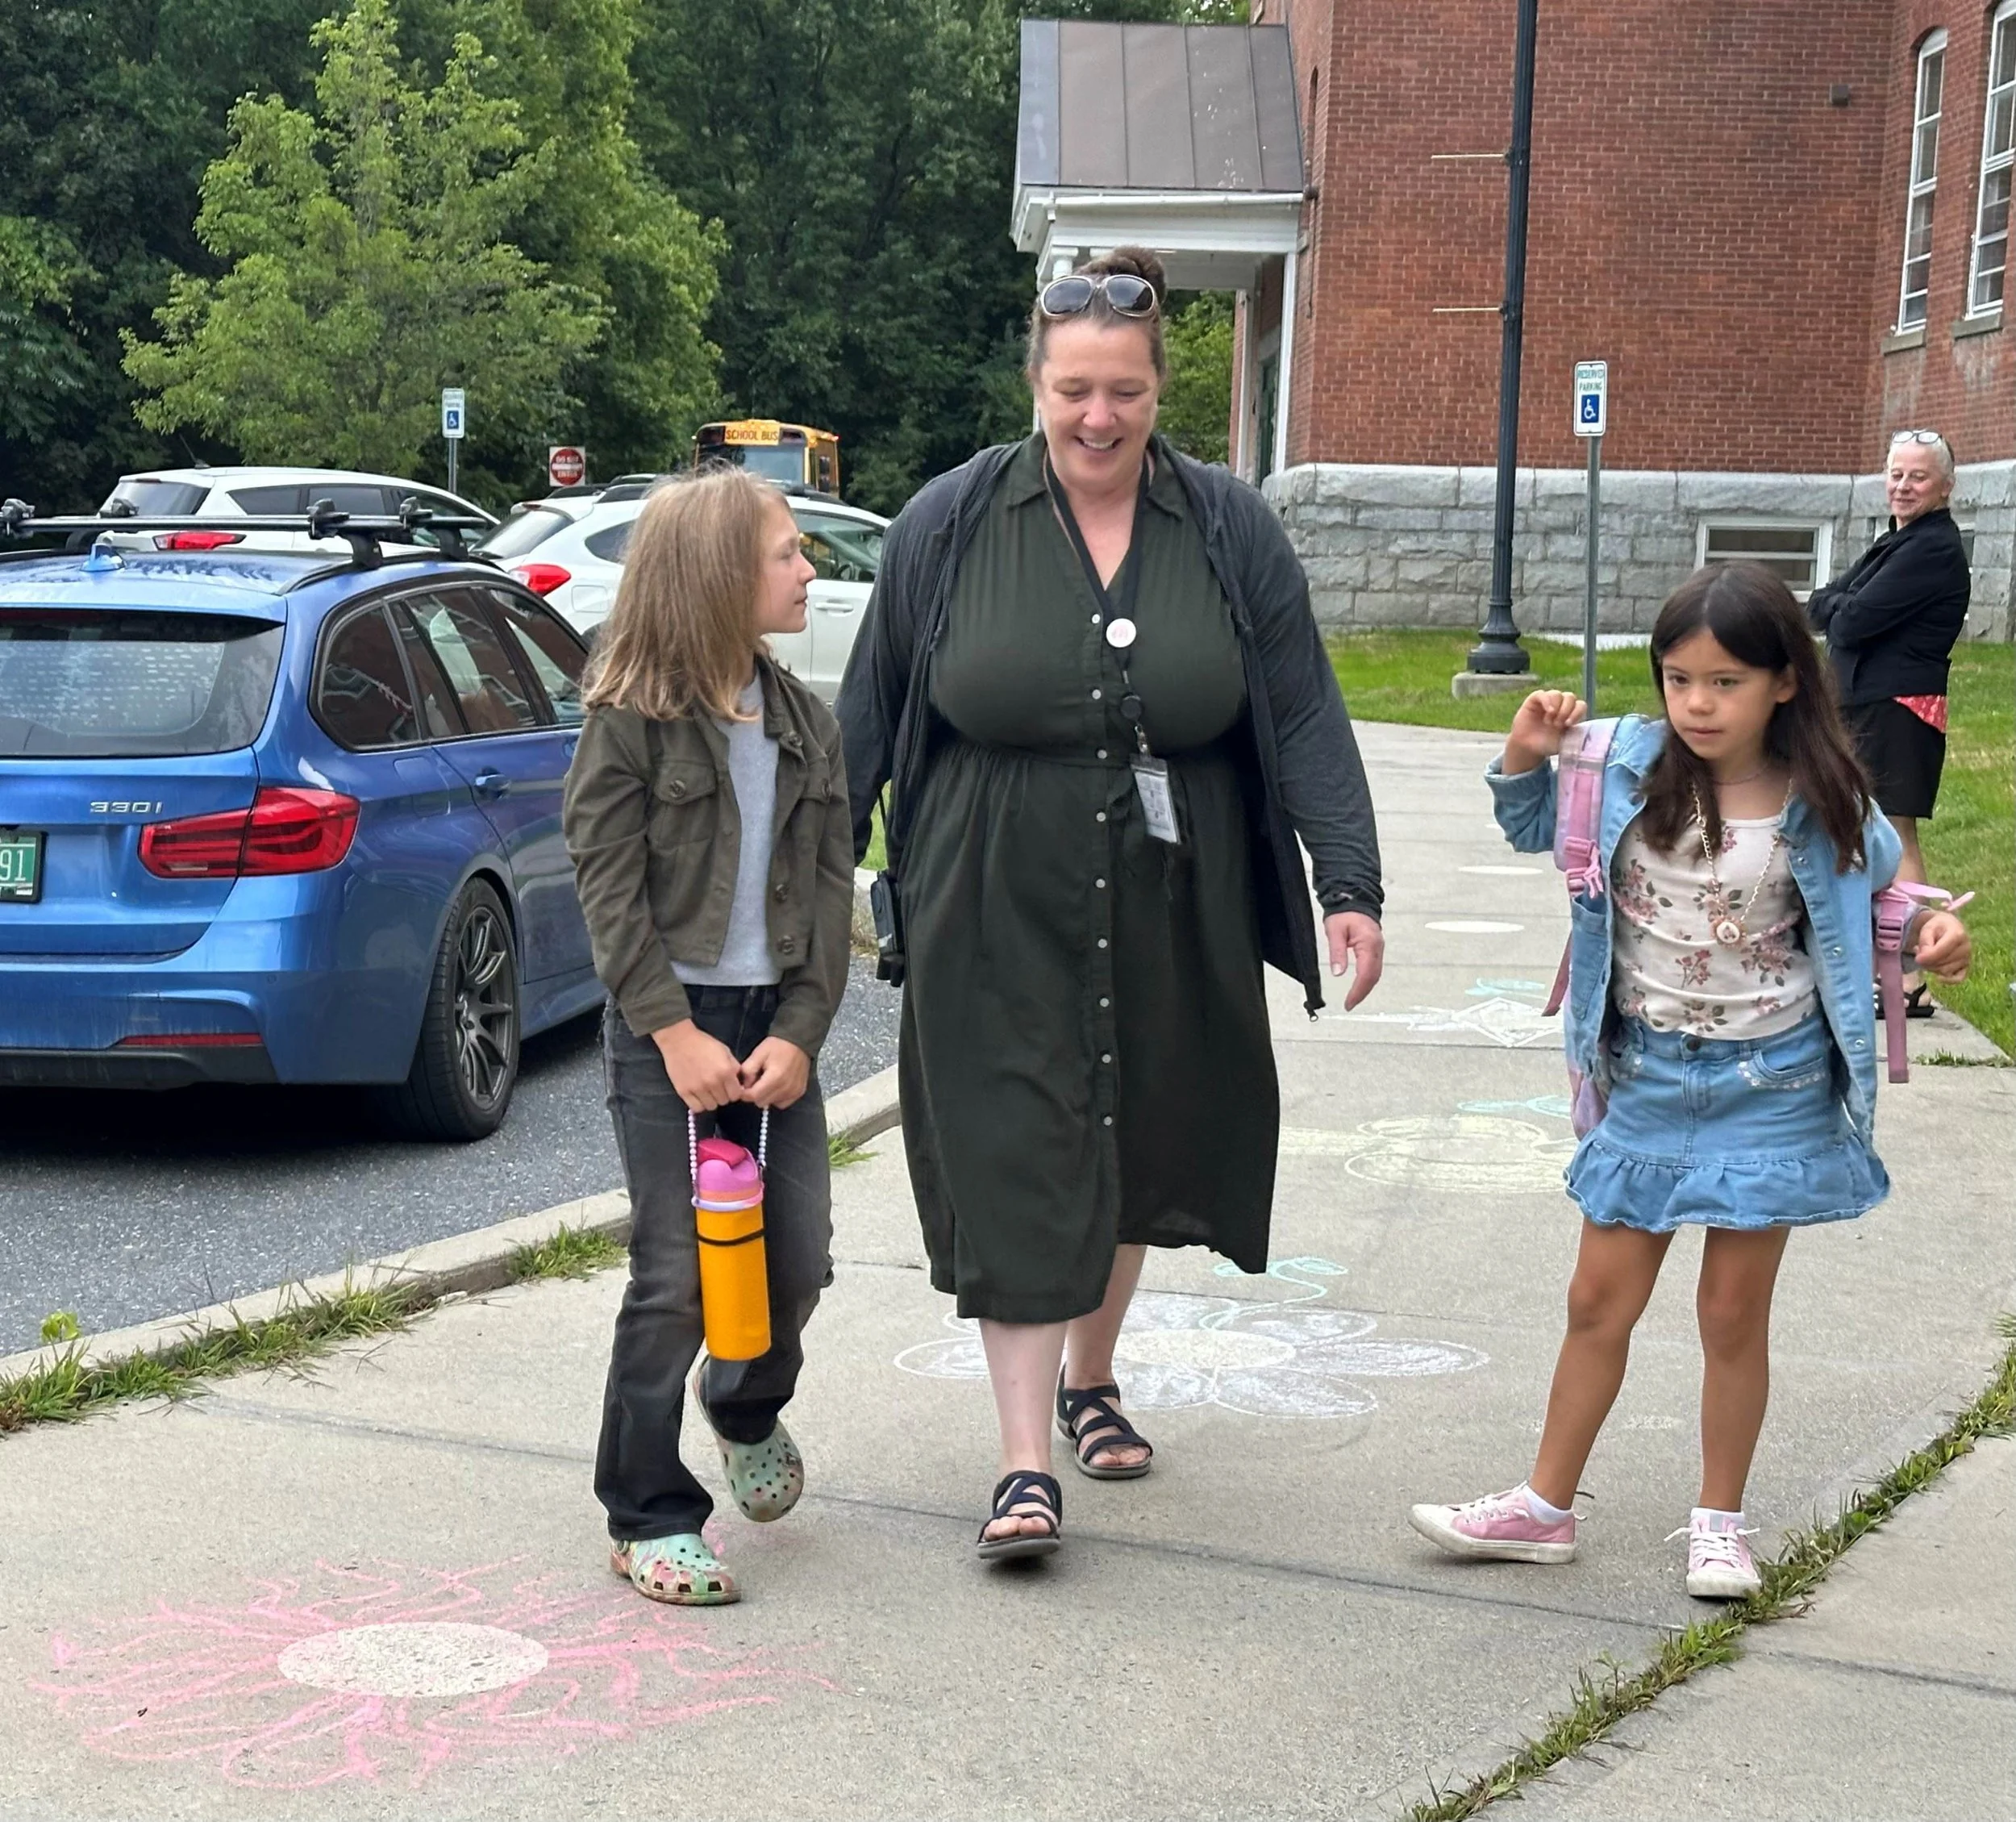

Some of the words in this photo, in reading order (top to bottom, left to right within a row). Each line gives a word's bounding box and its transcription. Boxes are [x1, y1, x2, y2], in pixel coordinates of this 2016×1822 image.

[1579, 381, 1602, 392] PARKING
[727, 430, 758, 440] SCHOOL
[761, 431, 778, 440] BUS
